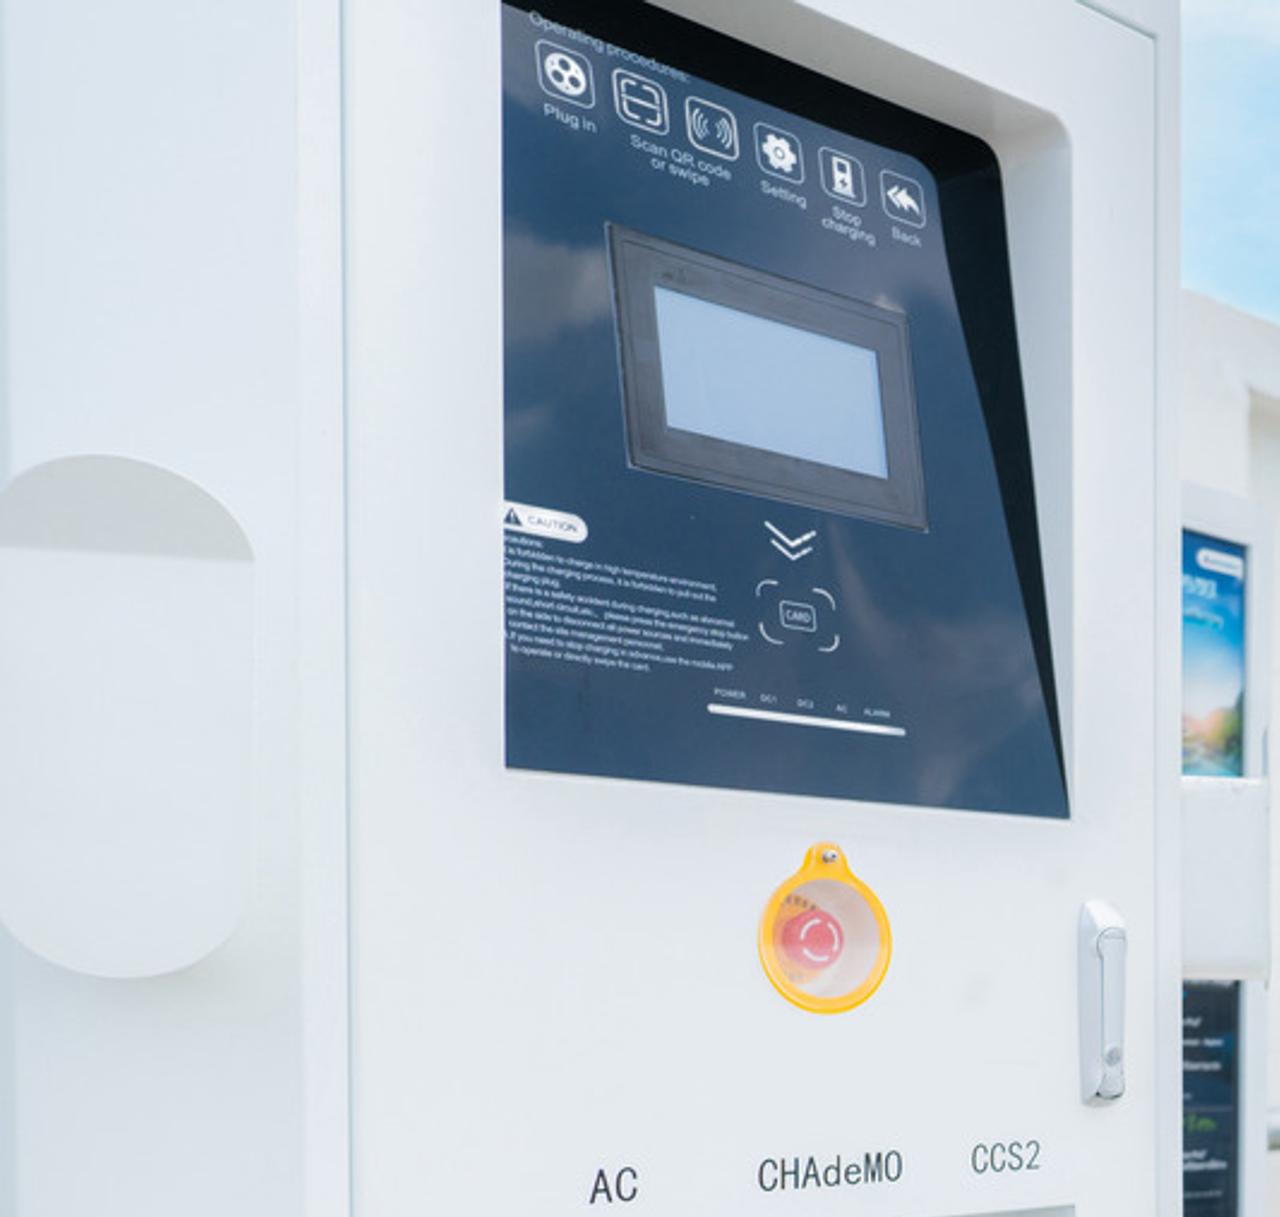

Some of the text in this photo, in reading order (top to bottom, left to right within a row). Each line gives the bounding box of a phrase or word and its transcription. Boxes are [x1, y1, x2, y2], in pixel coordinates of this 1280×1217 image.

[529, 10, 605, 53] Operating
[543, 102, 597, 133] Plug in
[629, 135, 732, 180] Scan QR code
[650, 157, 710, 187] or swipe
[760, 179, 807, 210] Setting
[832, 205, 862, 227] Stop
[821, 217, 876, 247] charging
[892, 226, 922, 248] Back
[527, 515, 578, 533] CAUTION
[516, 549, 554, 562] forbidden
[566, 558, 593, 570] charge
[604, 564, 621, 575] high
[623, 568, 667, 582] temperature
[546, 567, 580, 580] charging
[630, 581, 667, 594] forbidden
[512, 584, 532, 593] there
[550, 592, 574, 602] safety
[576, 596, 609, 606] accident
[611, 601, 635, 613] during
[700, 616, 734, 627] abnormal
[785, 609, 812, 624] CARD
[508, 621, 538, 630] contact
[570, 631, 621, 643] management
[534, 612, 552, 620] side
[563, 616, 604, 629] disconnect
[617, 627, 640, 635] power
[642, 631, 672, 640] sources
[690, 637, 733, 651] immediately
[604, 612, 629, 621] please
[667, 624, 708, 636] emergency
[710, 629, 724, 639] stop
[726, 631, 748, 640] button
[520, 647, 551, 656] operate
[563, 652, 592, 664] directly
[566, 641, 582, 651] stop
[585, 644, 618, 656] charging
[714, 686, 747, 700] POWER
[760, 693, 778, 705] DC1
[757, 1150, 903, 1192] CHAdeMO
[971, 1139, 1042, 1175] CCS2
[589, 1165, 639, 1205] AC
